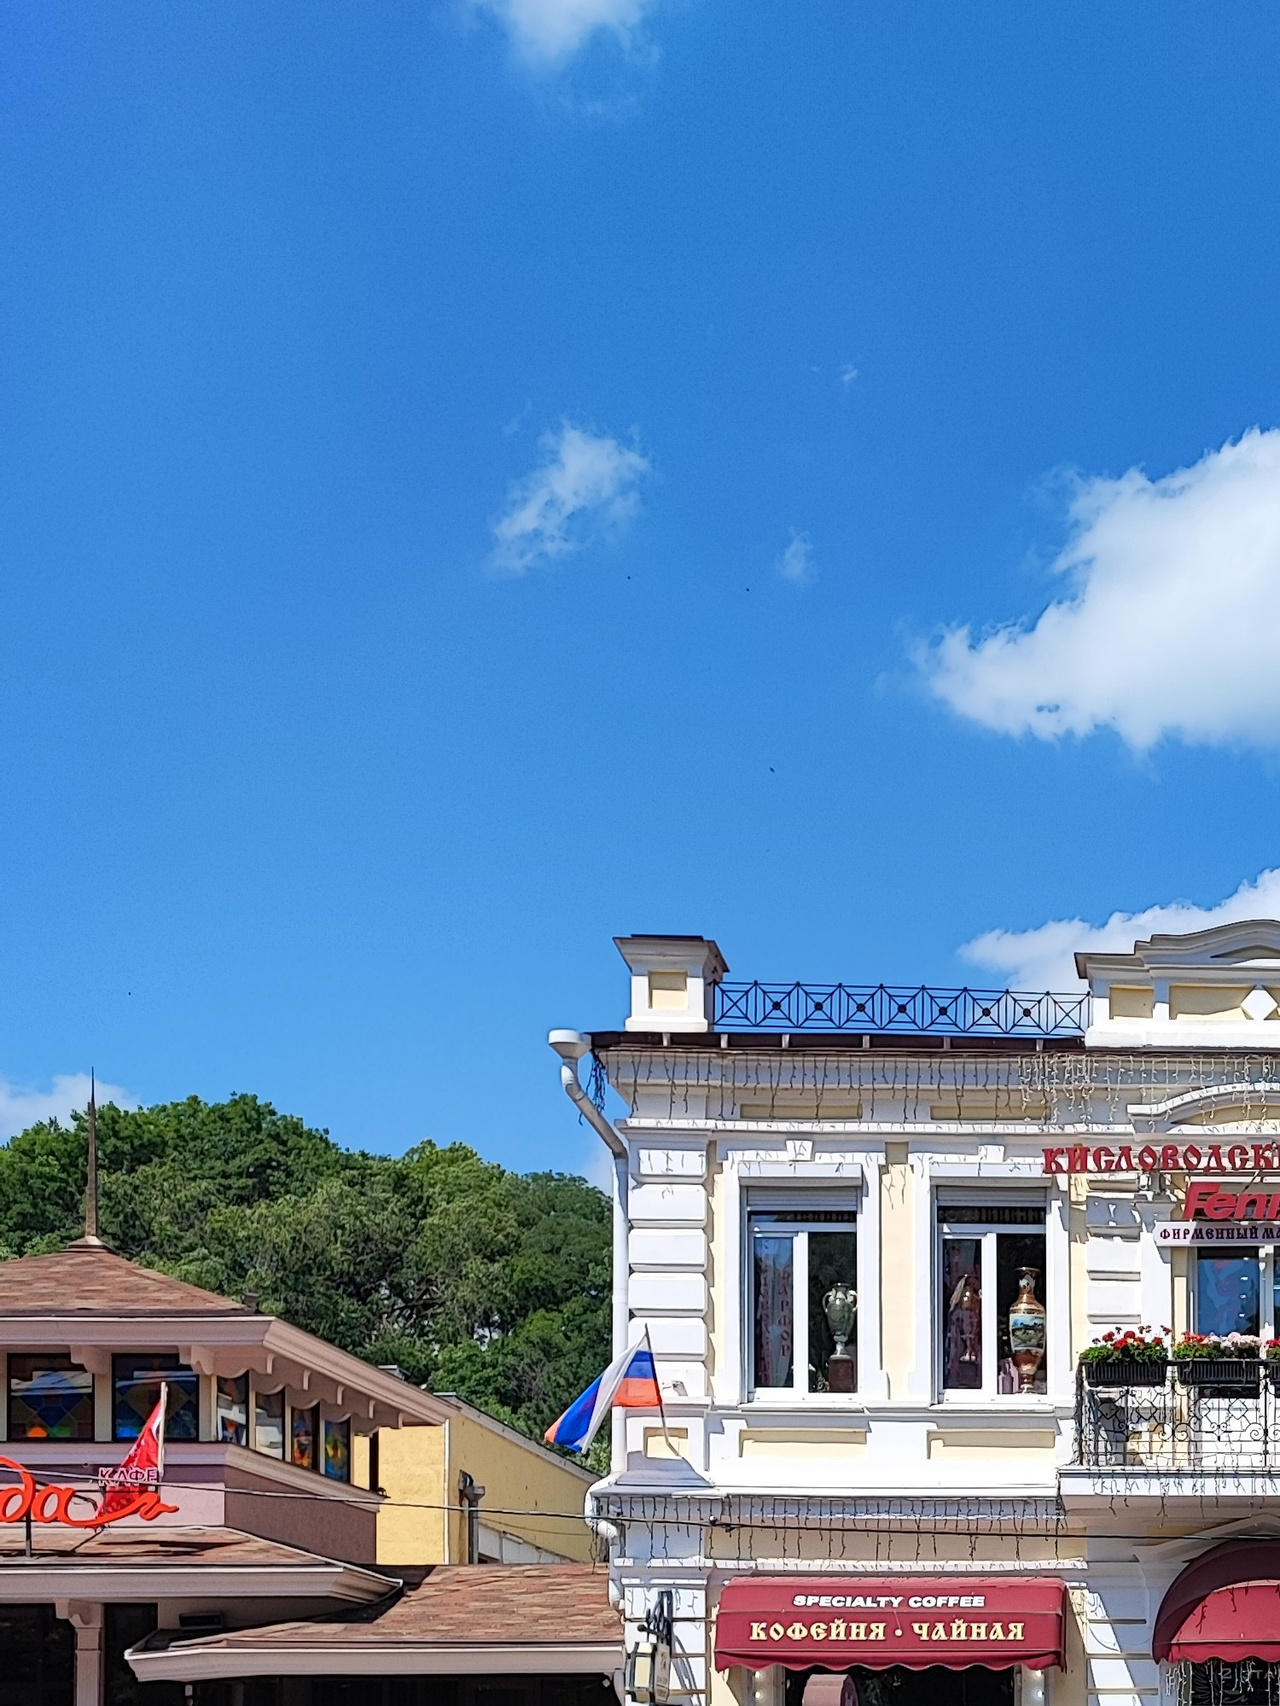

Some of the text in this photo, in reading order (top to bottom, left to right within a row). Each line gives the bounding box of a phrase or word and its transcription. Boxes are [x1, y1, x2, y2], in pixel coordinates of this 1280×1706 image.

[98, 1467, 158, 1487] КАФЕ
[793, 1595, 985, 1608] SPECIALTY COFFEE
[749, 1618, 1025, 1641] КОФЕЙНЯ ЧАЙНАЯ
